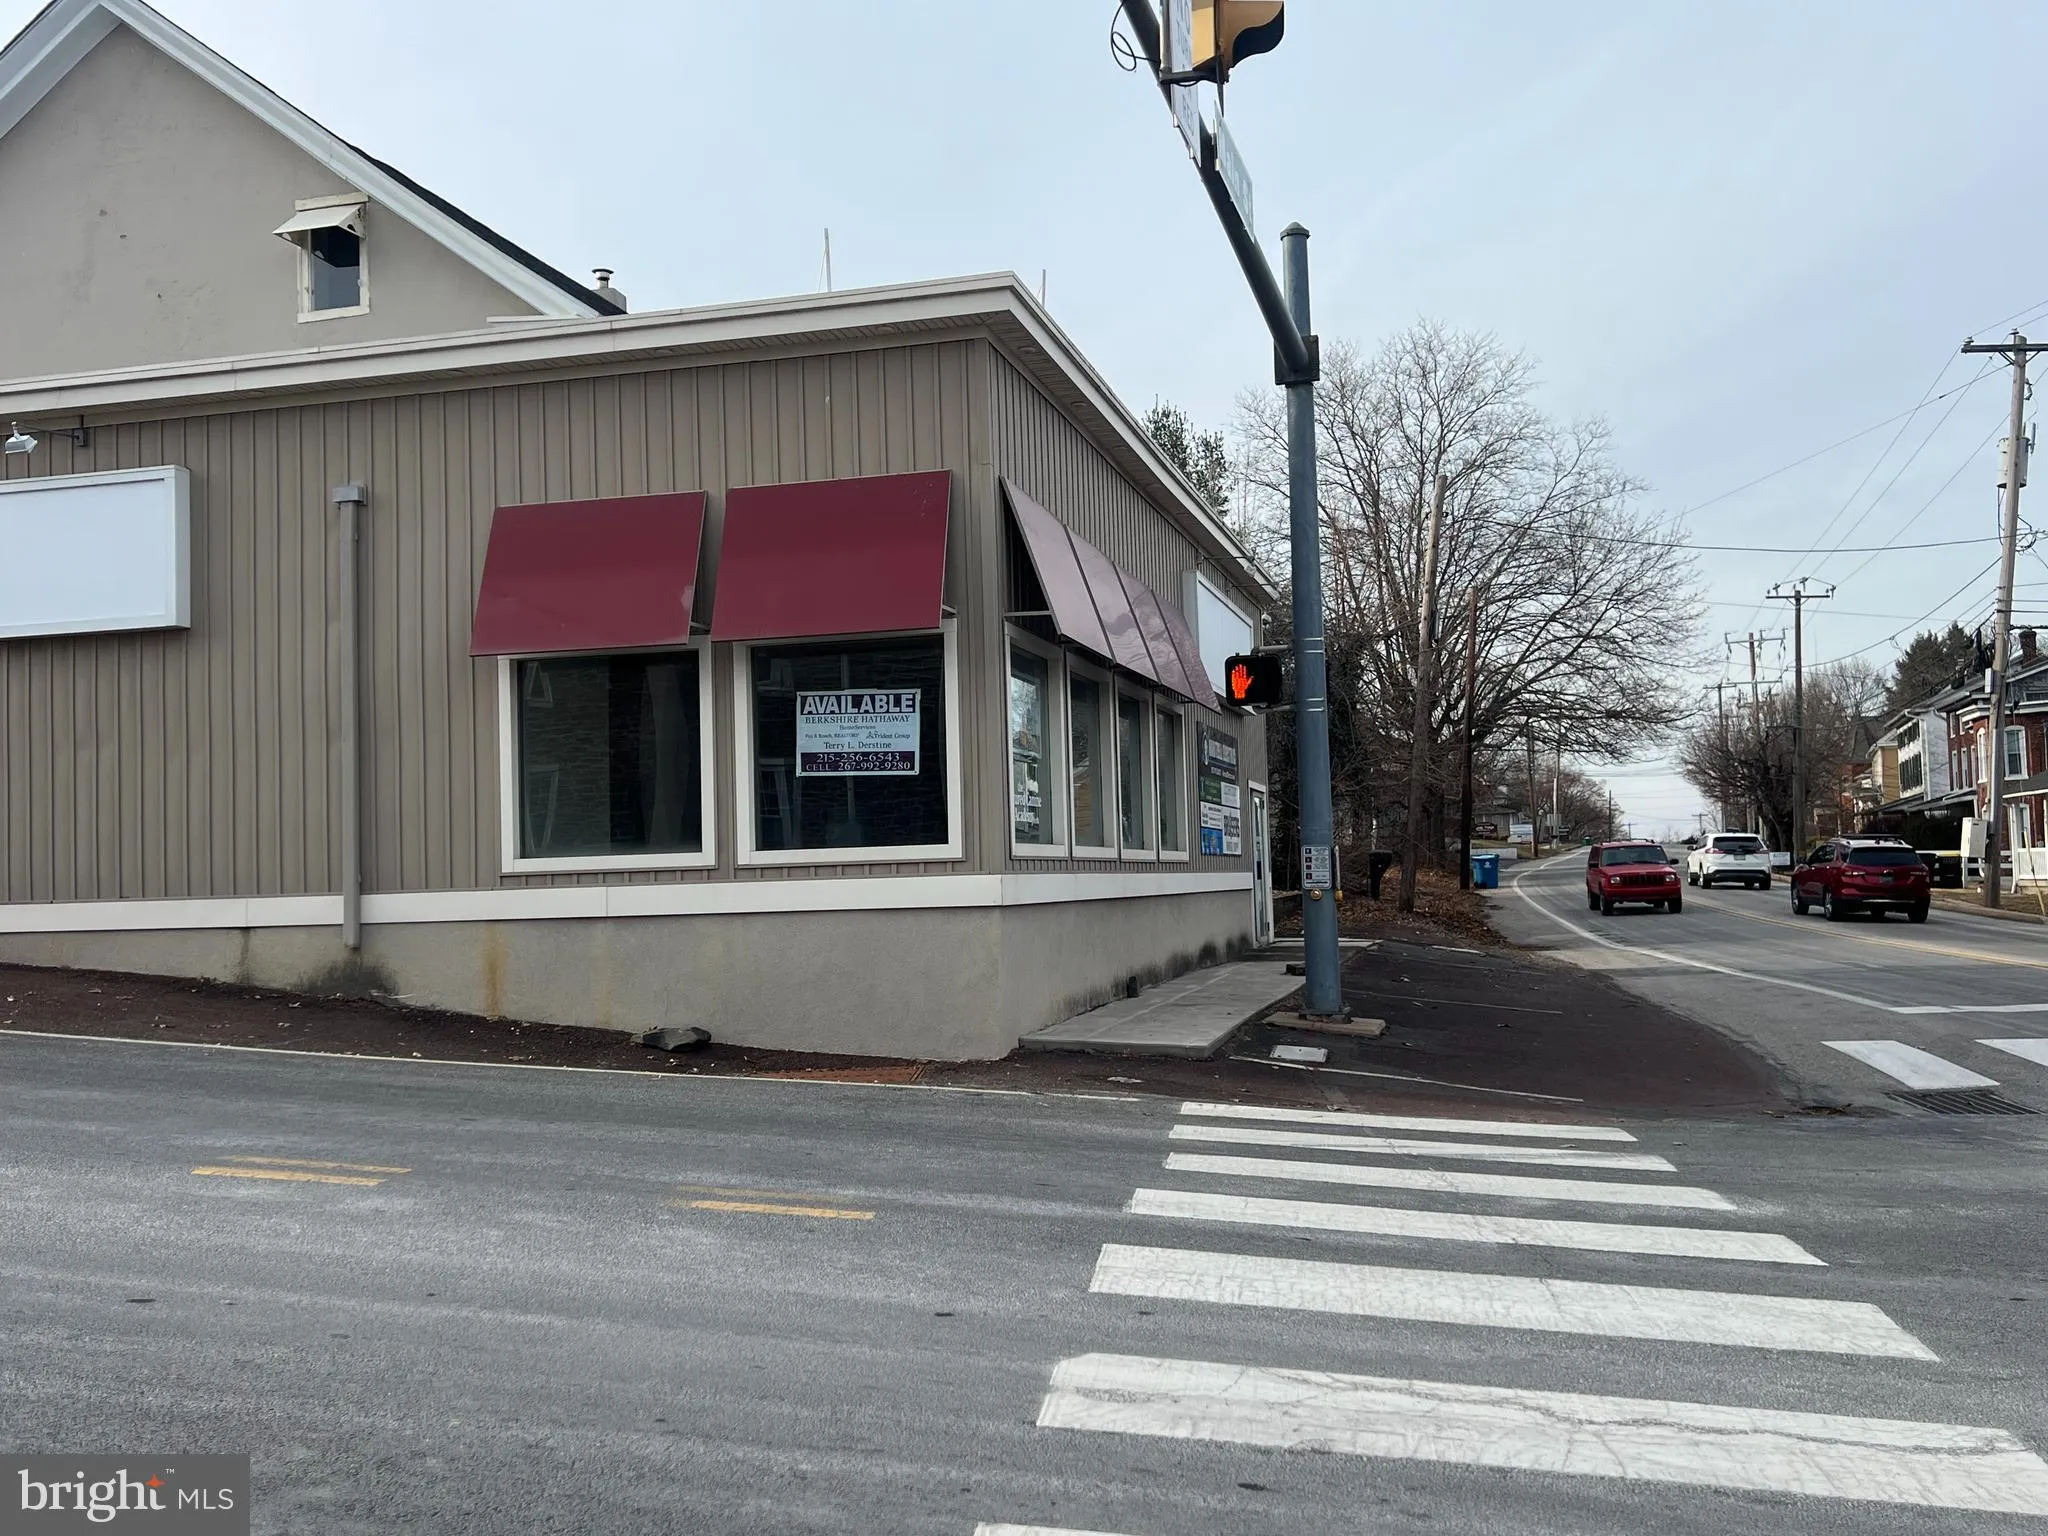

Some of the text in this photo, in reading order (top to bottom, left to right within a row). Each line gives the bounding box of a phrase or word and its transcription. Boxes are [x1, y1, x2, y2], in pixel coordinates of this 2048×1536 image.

[803, 695, 913, 714] AVAILABLE
[805, 714, 911, 724] BERKSHIRE HATHAWAY
[824, 742, 845, 750] Terry
[858, 741, 892, 749] Derstine
[816, 752, 900, 763] 215-256-6543
[838, 761, 911, 771] 267-992-9280
